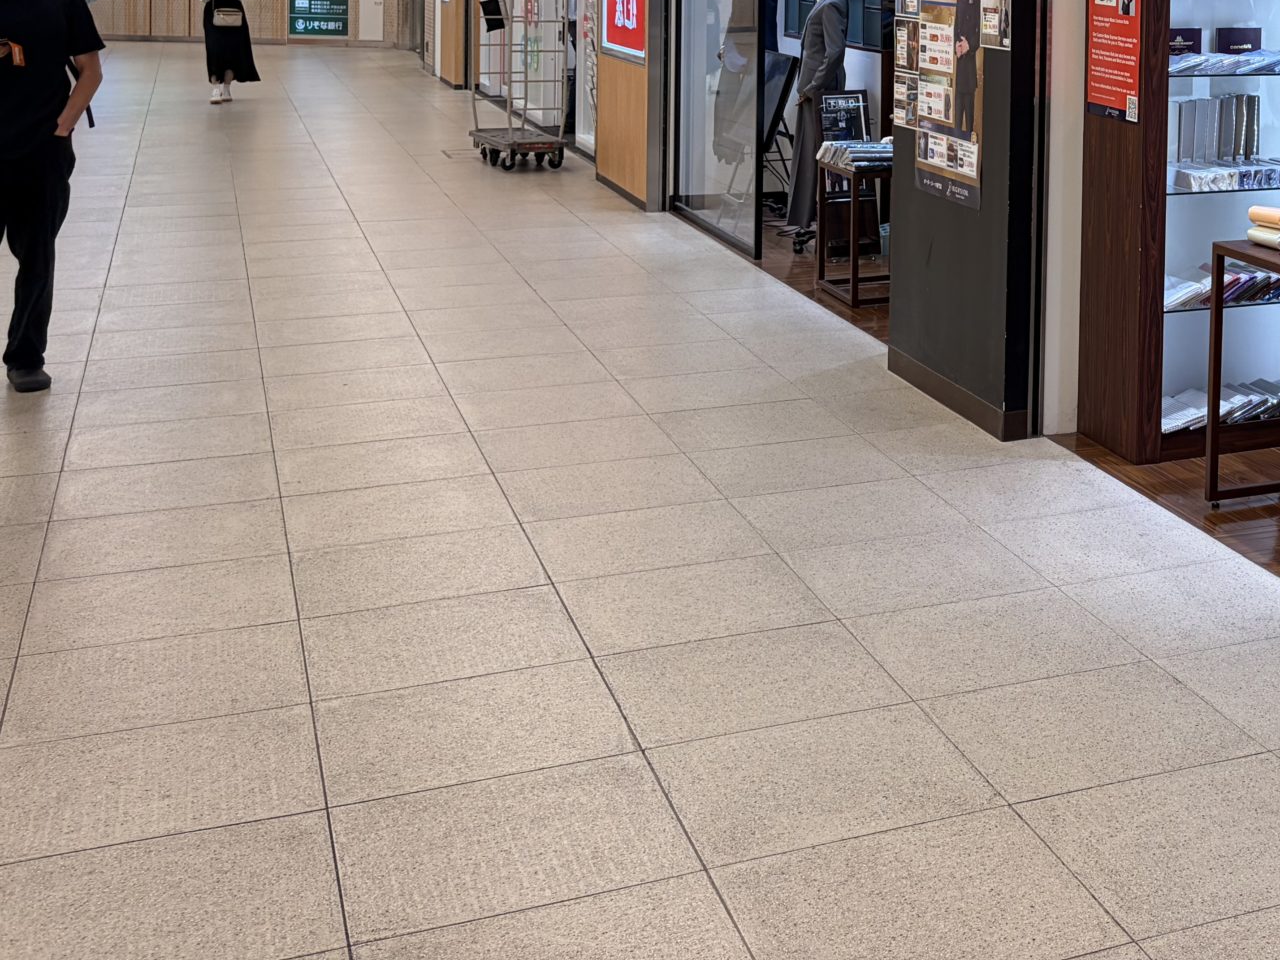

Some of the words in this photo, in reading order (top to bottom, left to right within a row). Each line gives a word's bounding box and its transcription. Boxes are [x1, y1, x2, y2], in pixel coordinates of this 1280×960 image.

[306, 20, 343, 30] りそな銀行
